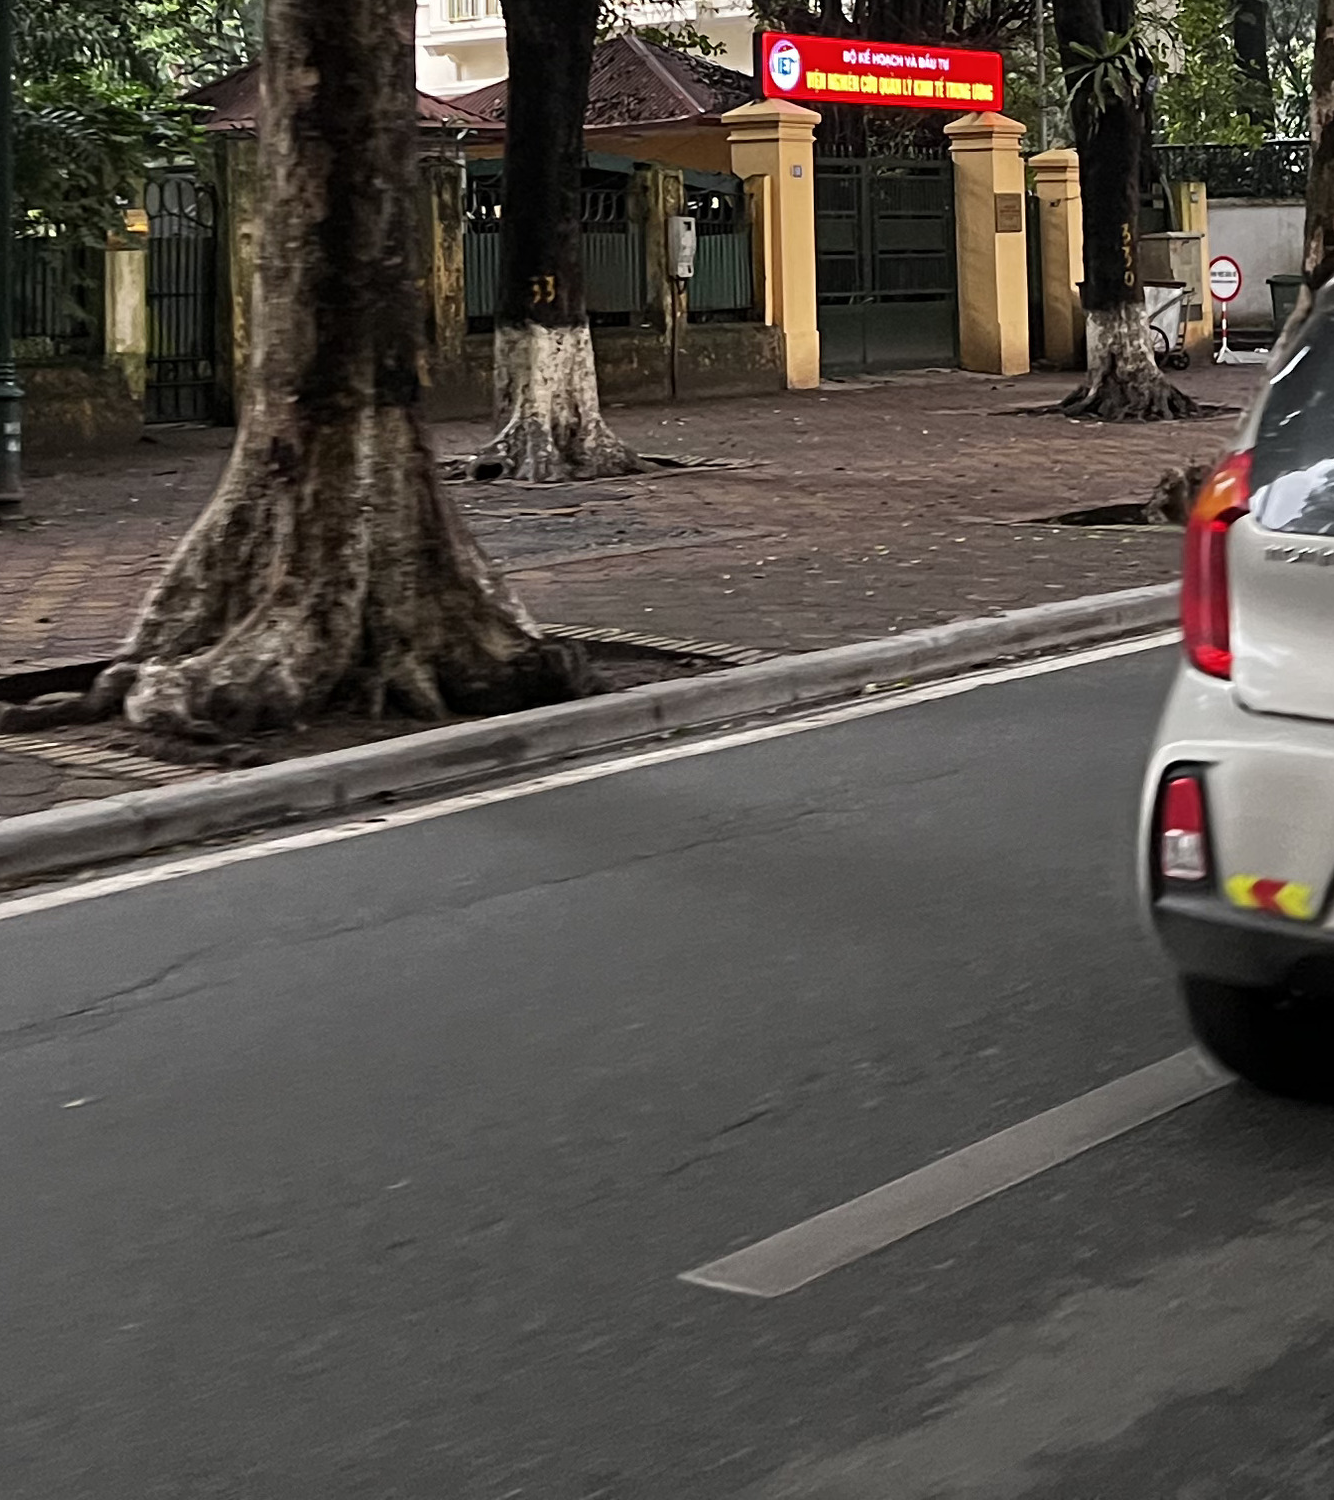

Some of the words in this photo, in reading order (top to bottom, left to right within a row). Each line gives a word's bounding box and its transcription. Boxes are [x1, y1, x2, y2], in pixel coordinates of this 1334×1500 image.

[843, 49, 857, 64] BỘ
[858, 48, 871, 64] KẾ
[872, 53, 903, 68] HOẠCH
[904, 53, 917, 68] VÀ
